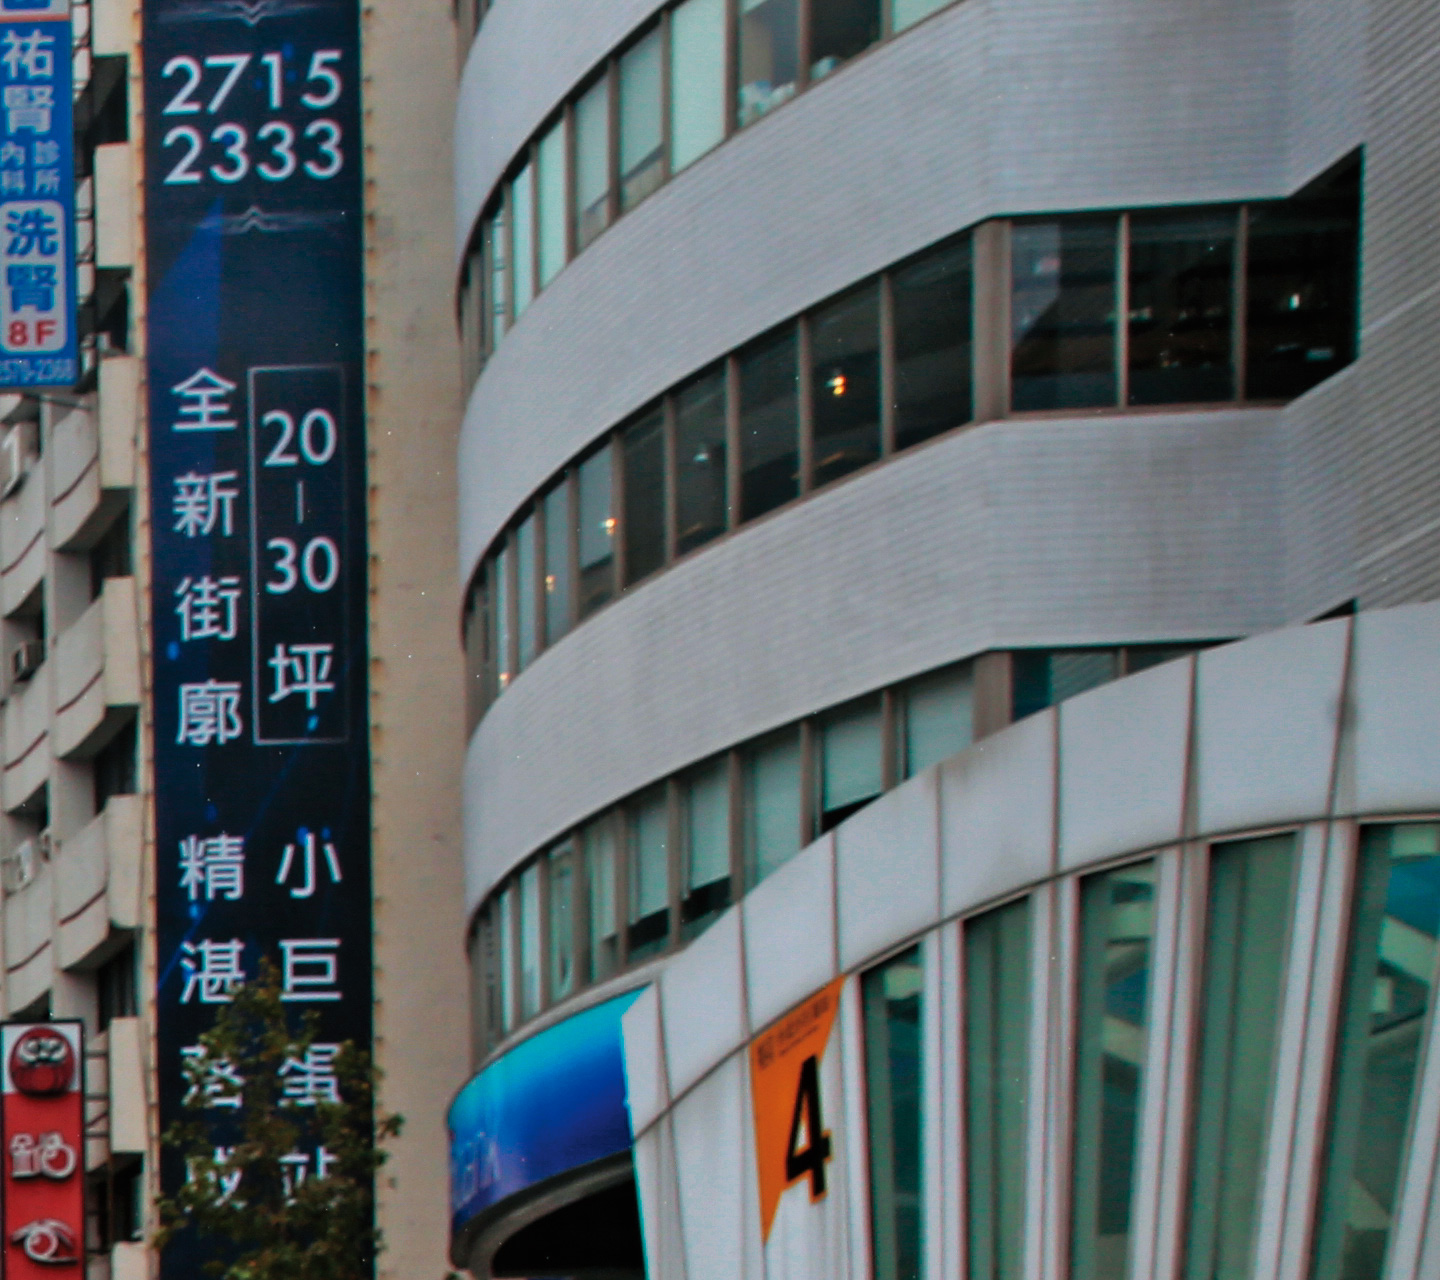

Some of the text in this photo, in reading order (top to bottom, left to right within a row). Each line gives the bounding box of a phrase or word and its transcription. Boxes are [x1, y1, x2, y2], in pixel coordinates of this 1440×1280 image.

[161, 49, 343, 115] 2715
[162, 118, 345, 184] 2333
[170, 367, 243, 747] 全新街廓
[786, 1055, 831, 1197] 4
